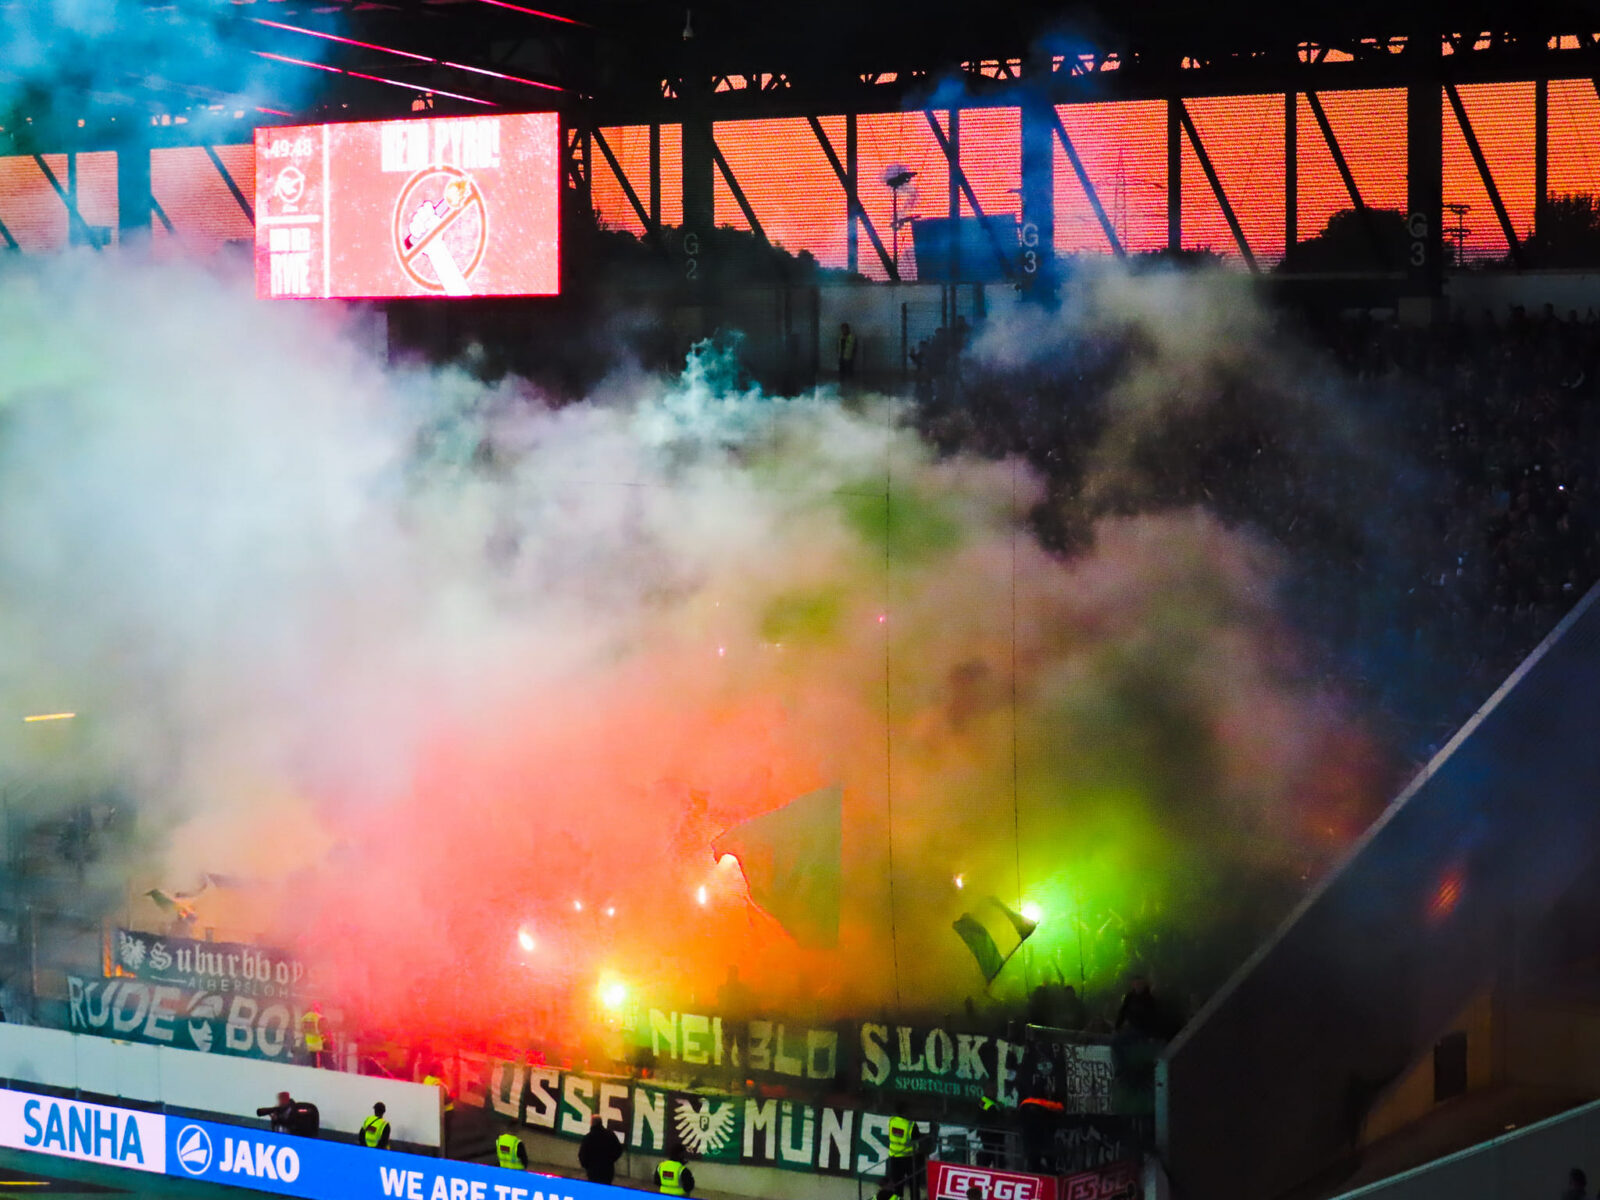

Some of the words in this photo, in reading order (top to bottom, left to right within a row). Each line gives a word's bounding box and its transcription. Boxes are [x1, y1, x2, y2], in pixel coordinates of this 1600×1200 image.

[67, 975, 182, 1042] RUDE
[860, 1022, 1025, 1108] SLOKE
[24, 1099, 144, 1165] SANHA
[443, 1048, 665, 1151] EUSSEN
[219, 1137, 300, 1183] JAKO
[379, 1166, 424, 1200] WE
[431, 1175, 488, 1200] ARE
